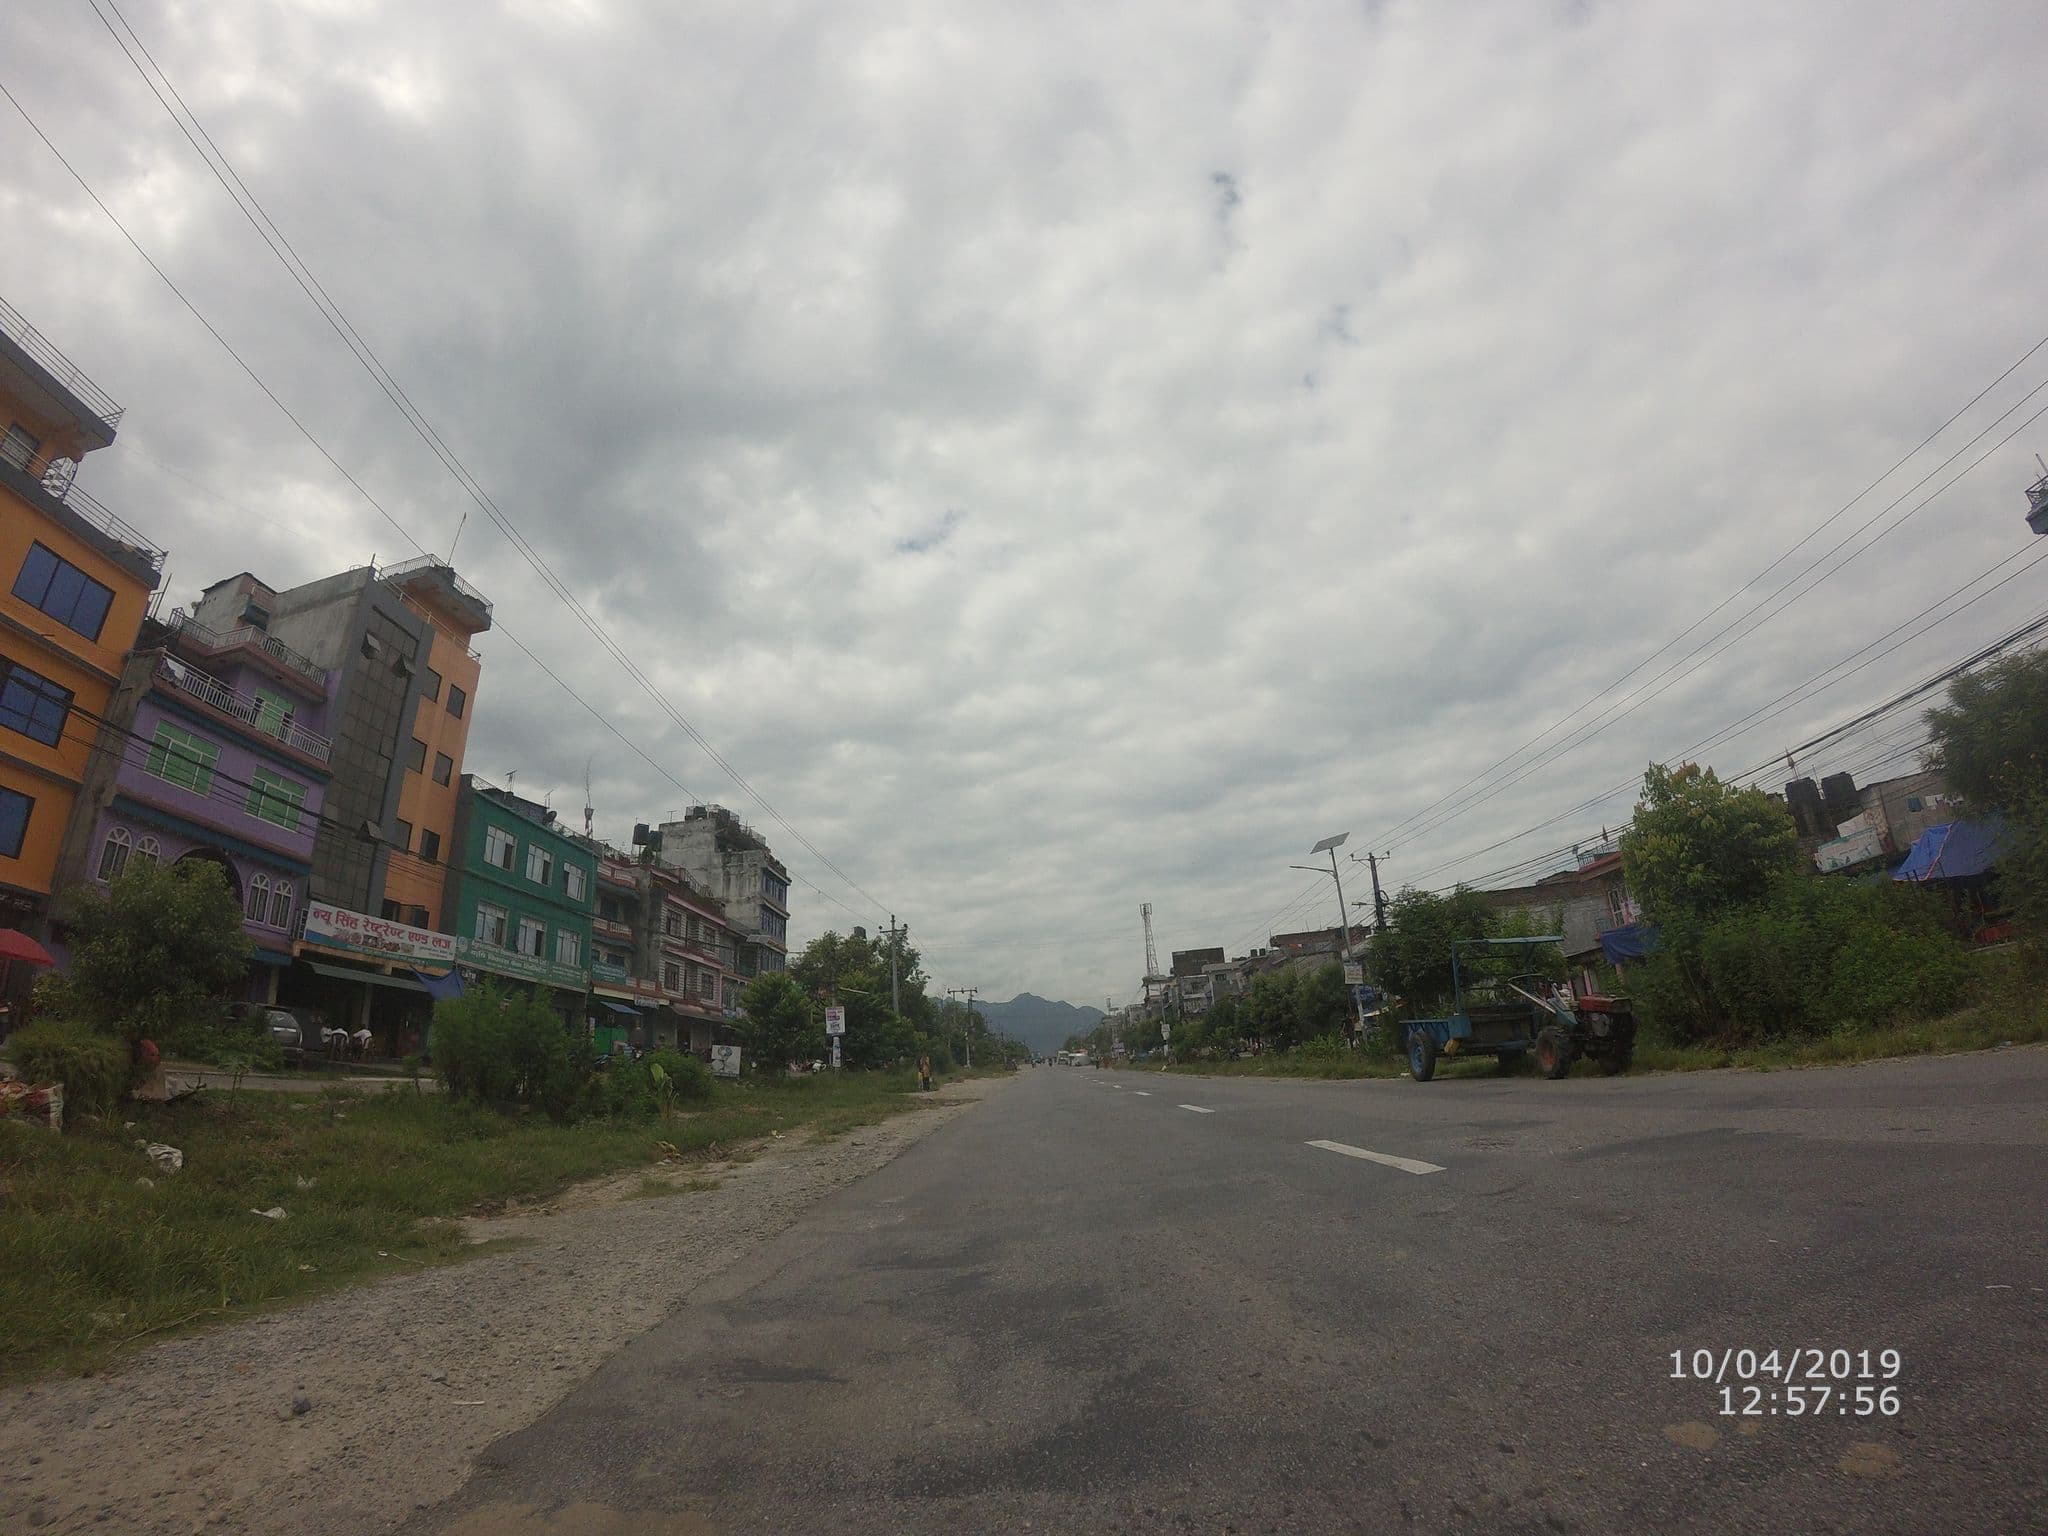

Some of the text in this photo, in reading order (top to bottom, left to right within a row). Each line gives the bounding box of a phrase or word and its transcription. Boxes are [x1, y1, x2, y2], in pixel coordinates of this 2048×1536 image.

[313, 907, 332, 926] न्यू
[407, 930, 430, 946] एण्ड
[431, 936, 453, 950] लज
